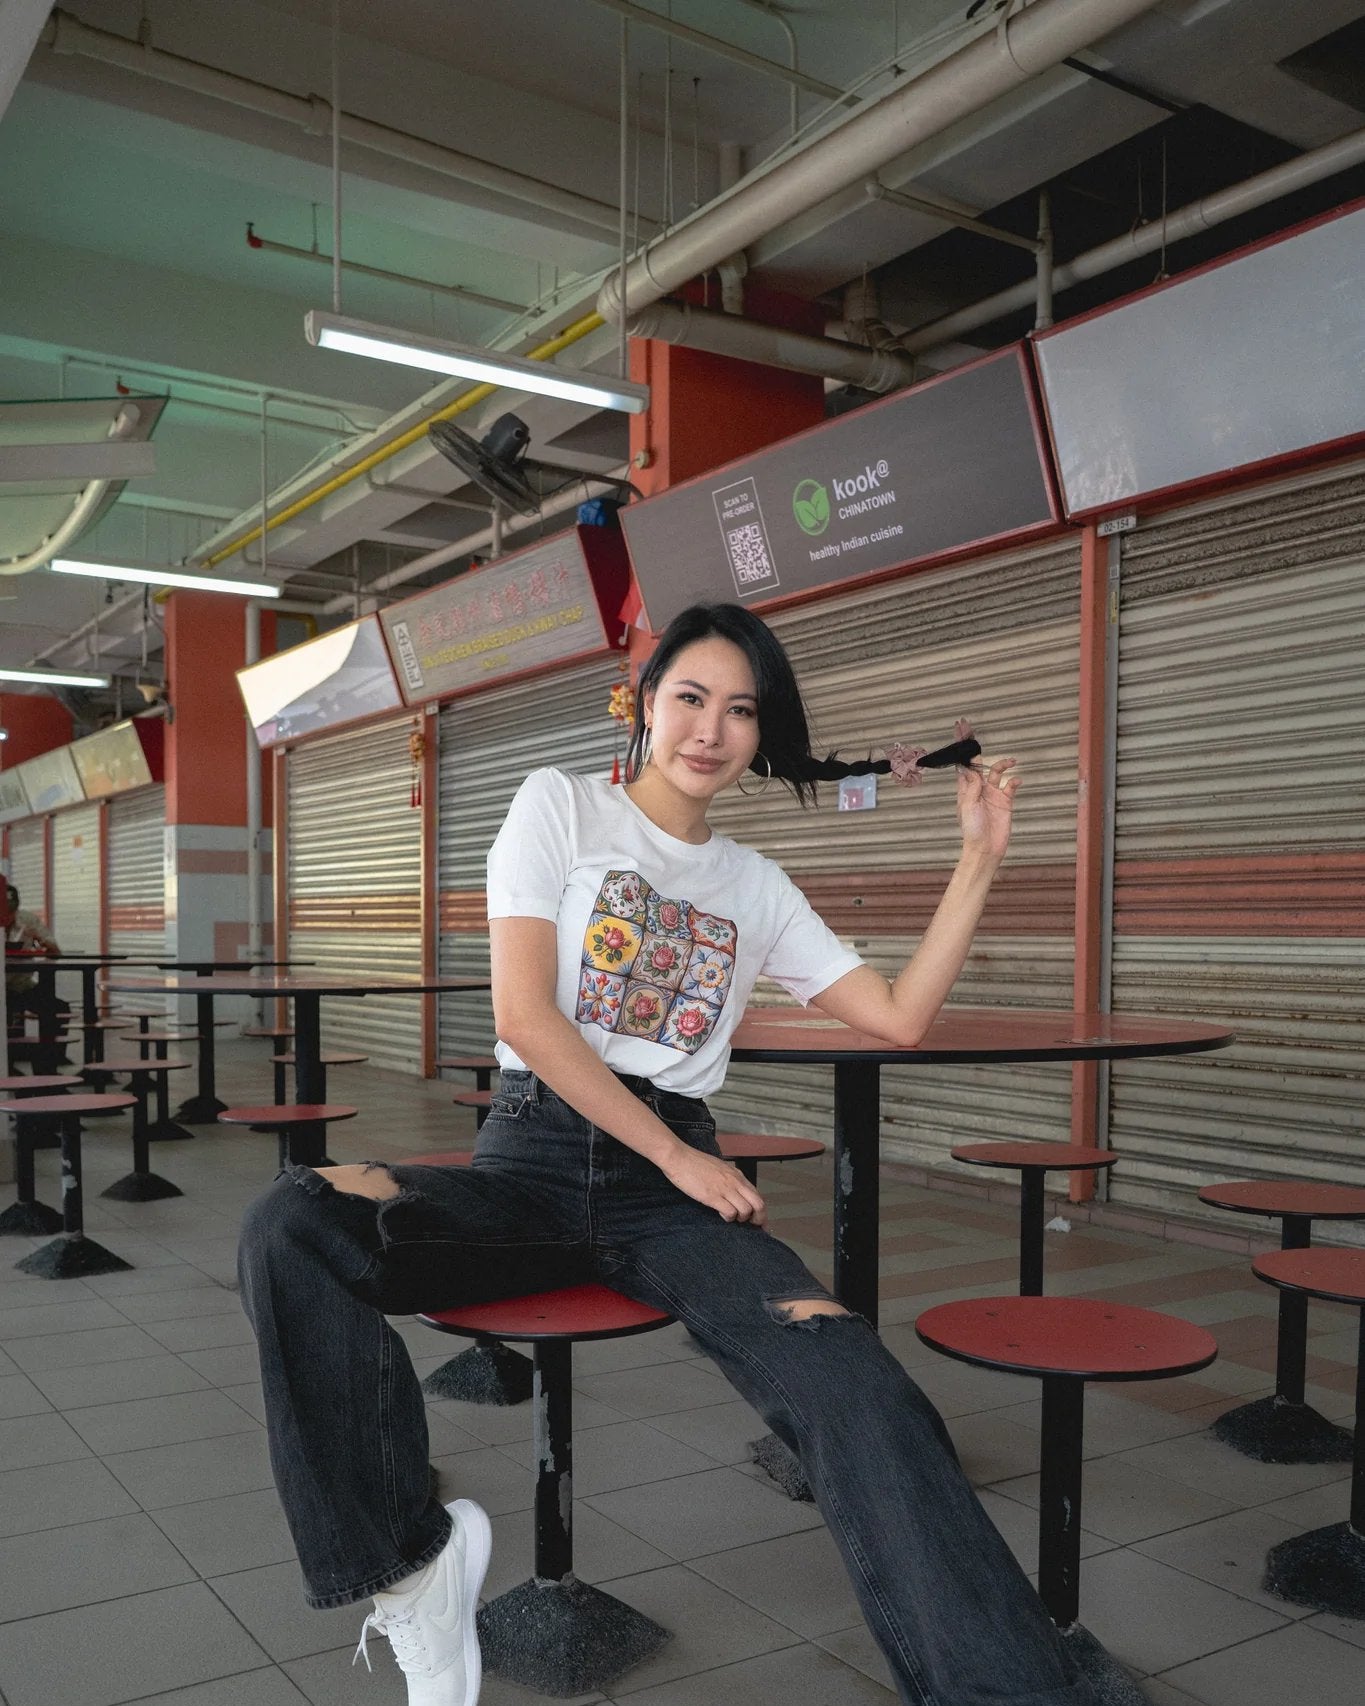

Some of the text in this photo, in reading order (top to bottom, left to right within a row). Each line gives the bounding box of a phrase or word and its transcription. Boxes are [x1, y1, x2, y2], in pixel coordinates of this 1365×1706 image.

[832, 459, 889, 501] kook@
[722, 502, 755, 519] PRE-ORDER
[723, 493, 748, 509] SCAN TO
[838, 491, 896, 520] CHINATOWN
[1104, 517, 1129, 533] 02-154
[809, 545, 840, 561] healthy
[870, 524, 904, 542] cuisine
